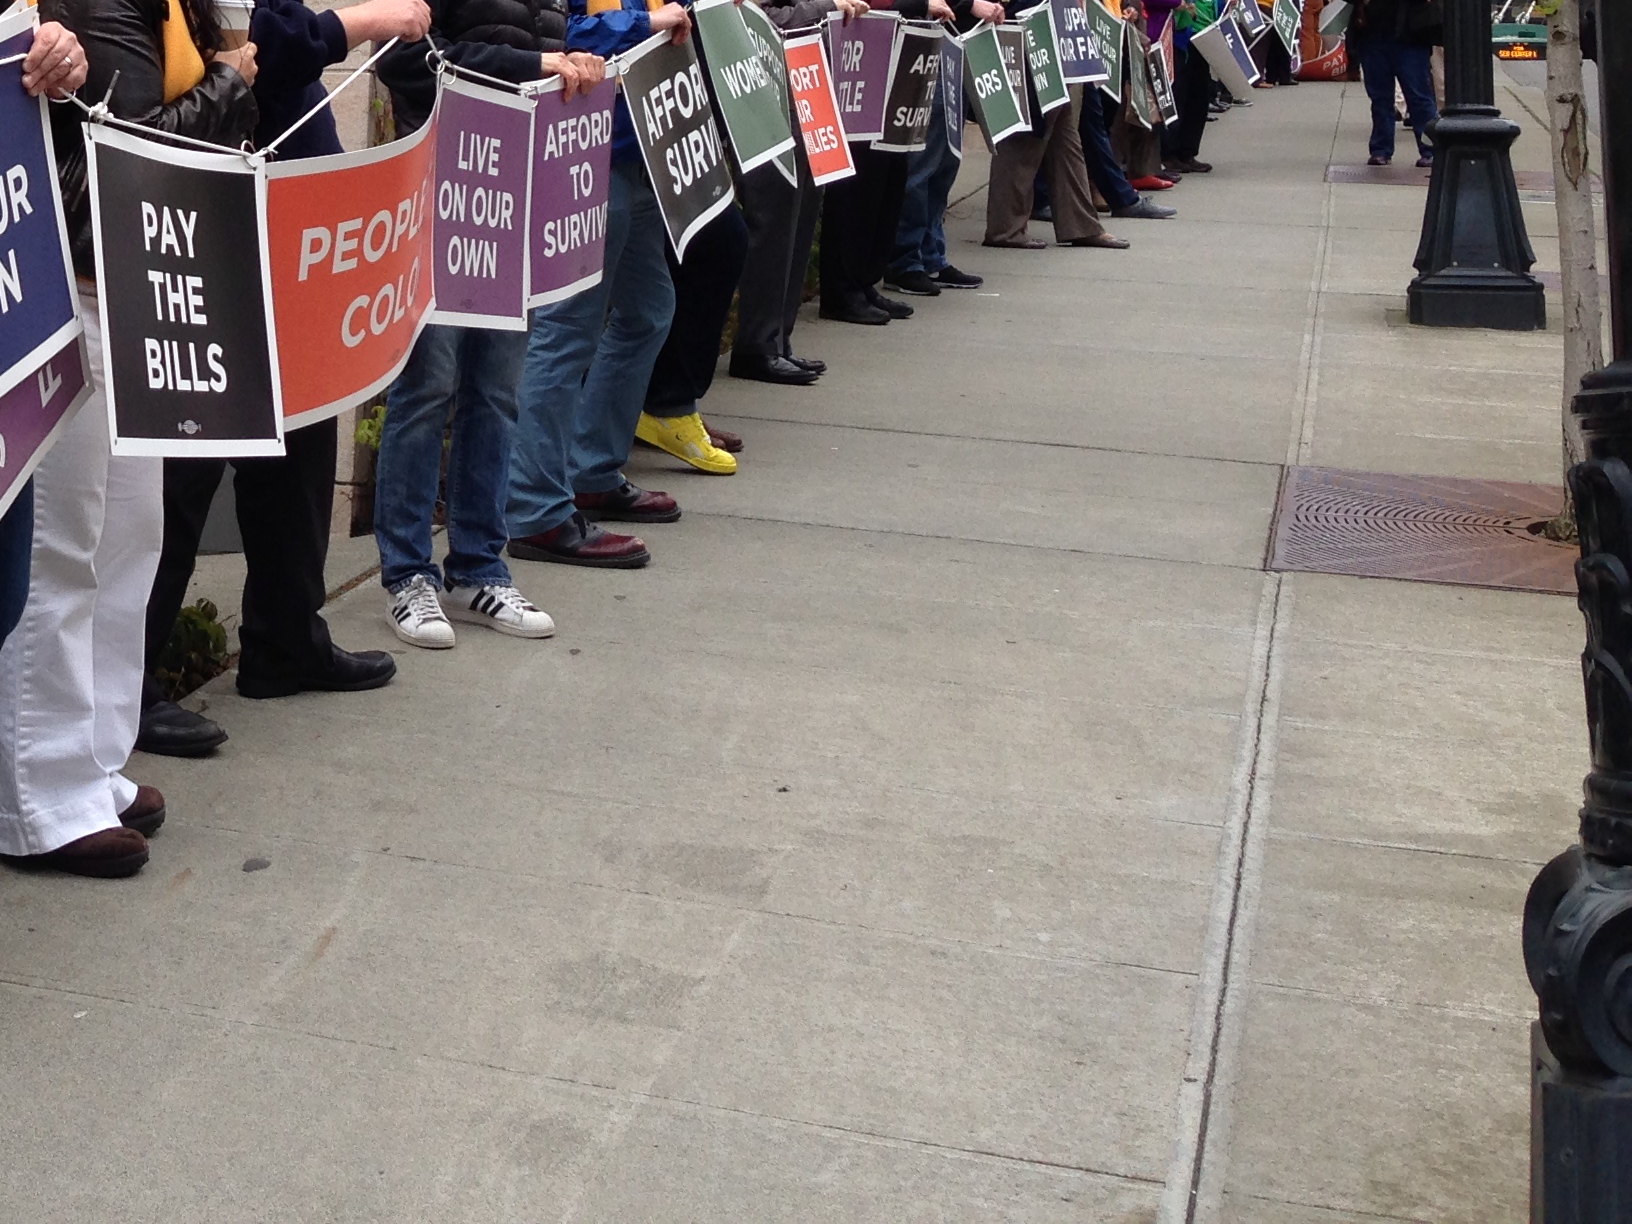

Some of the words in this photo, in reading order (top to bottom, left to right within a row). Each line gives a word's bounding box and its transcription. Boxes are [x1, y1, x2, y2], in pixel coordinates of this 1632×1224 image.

[1096, 16, 1111, 40] LIVE
[1029, 48, 1050, 70] OUR
[1102, 41, 1117, 64] OUR
[1323, 52, 1343, 70] PAY
[642, 60, 708, 146] AFFOR
[974, 69, 1002, 99] ORS
[458, 130, 501, 176] LIVE
[544, 109, 612, 161] AFFORD
[570, 161, 593, 200] TO
[439, 180, 467, 222] ON
[472, 187, 513, 230] OUR
[141, 201, 198, 259] PAY
[447, 235, 497, 279] OWN
[148, 269, 208, 326] THE
[144, 338, 227, 393] BILLS
